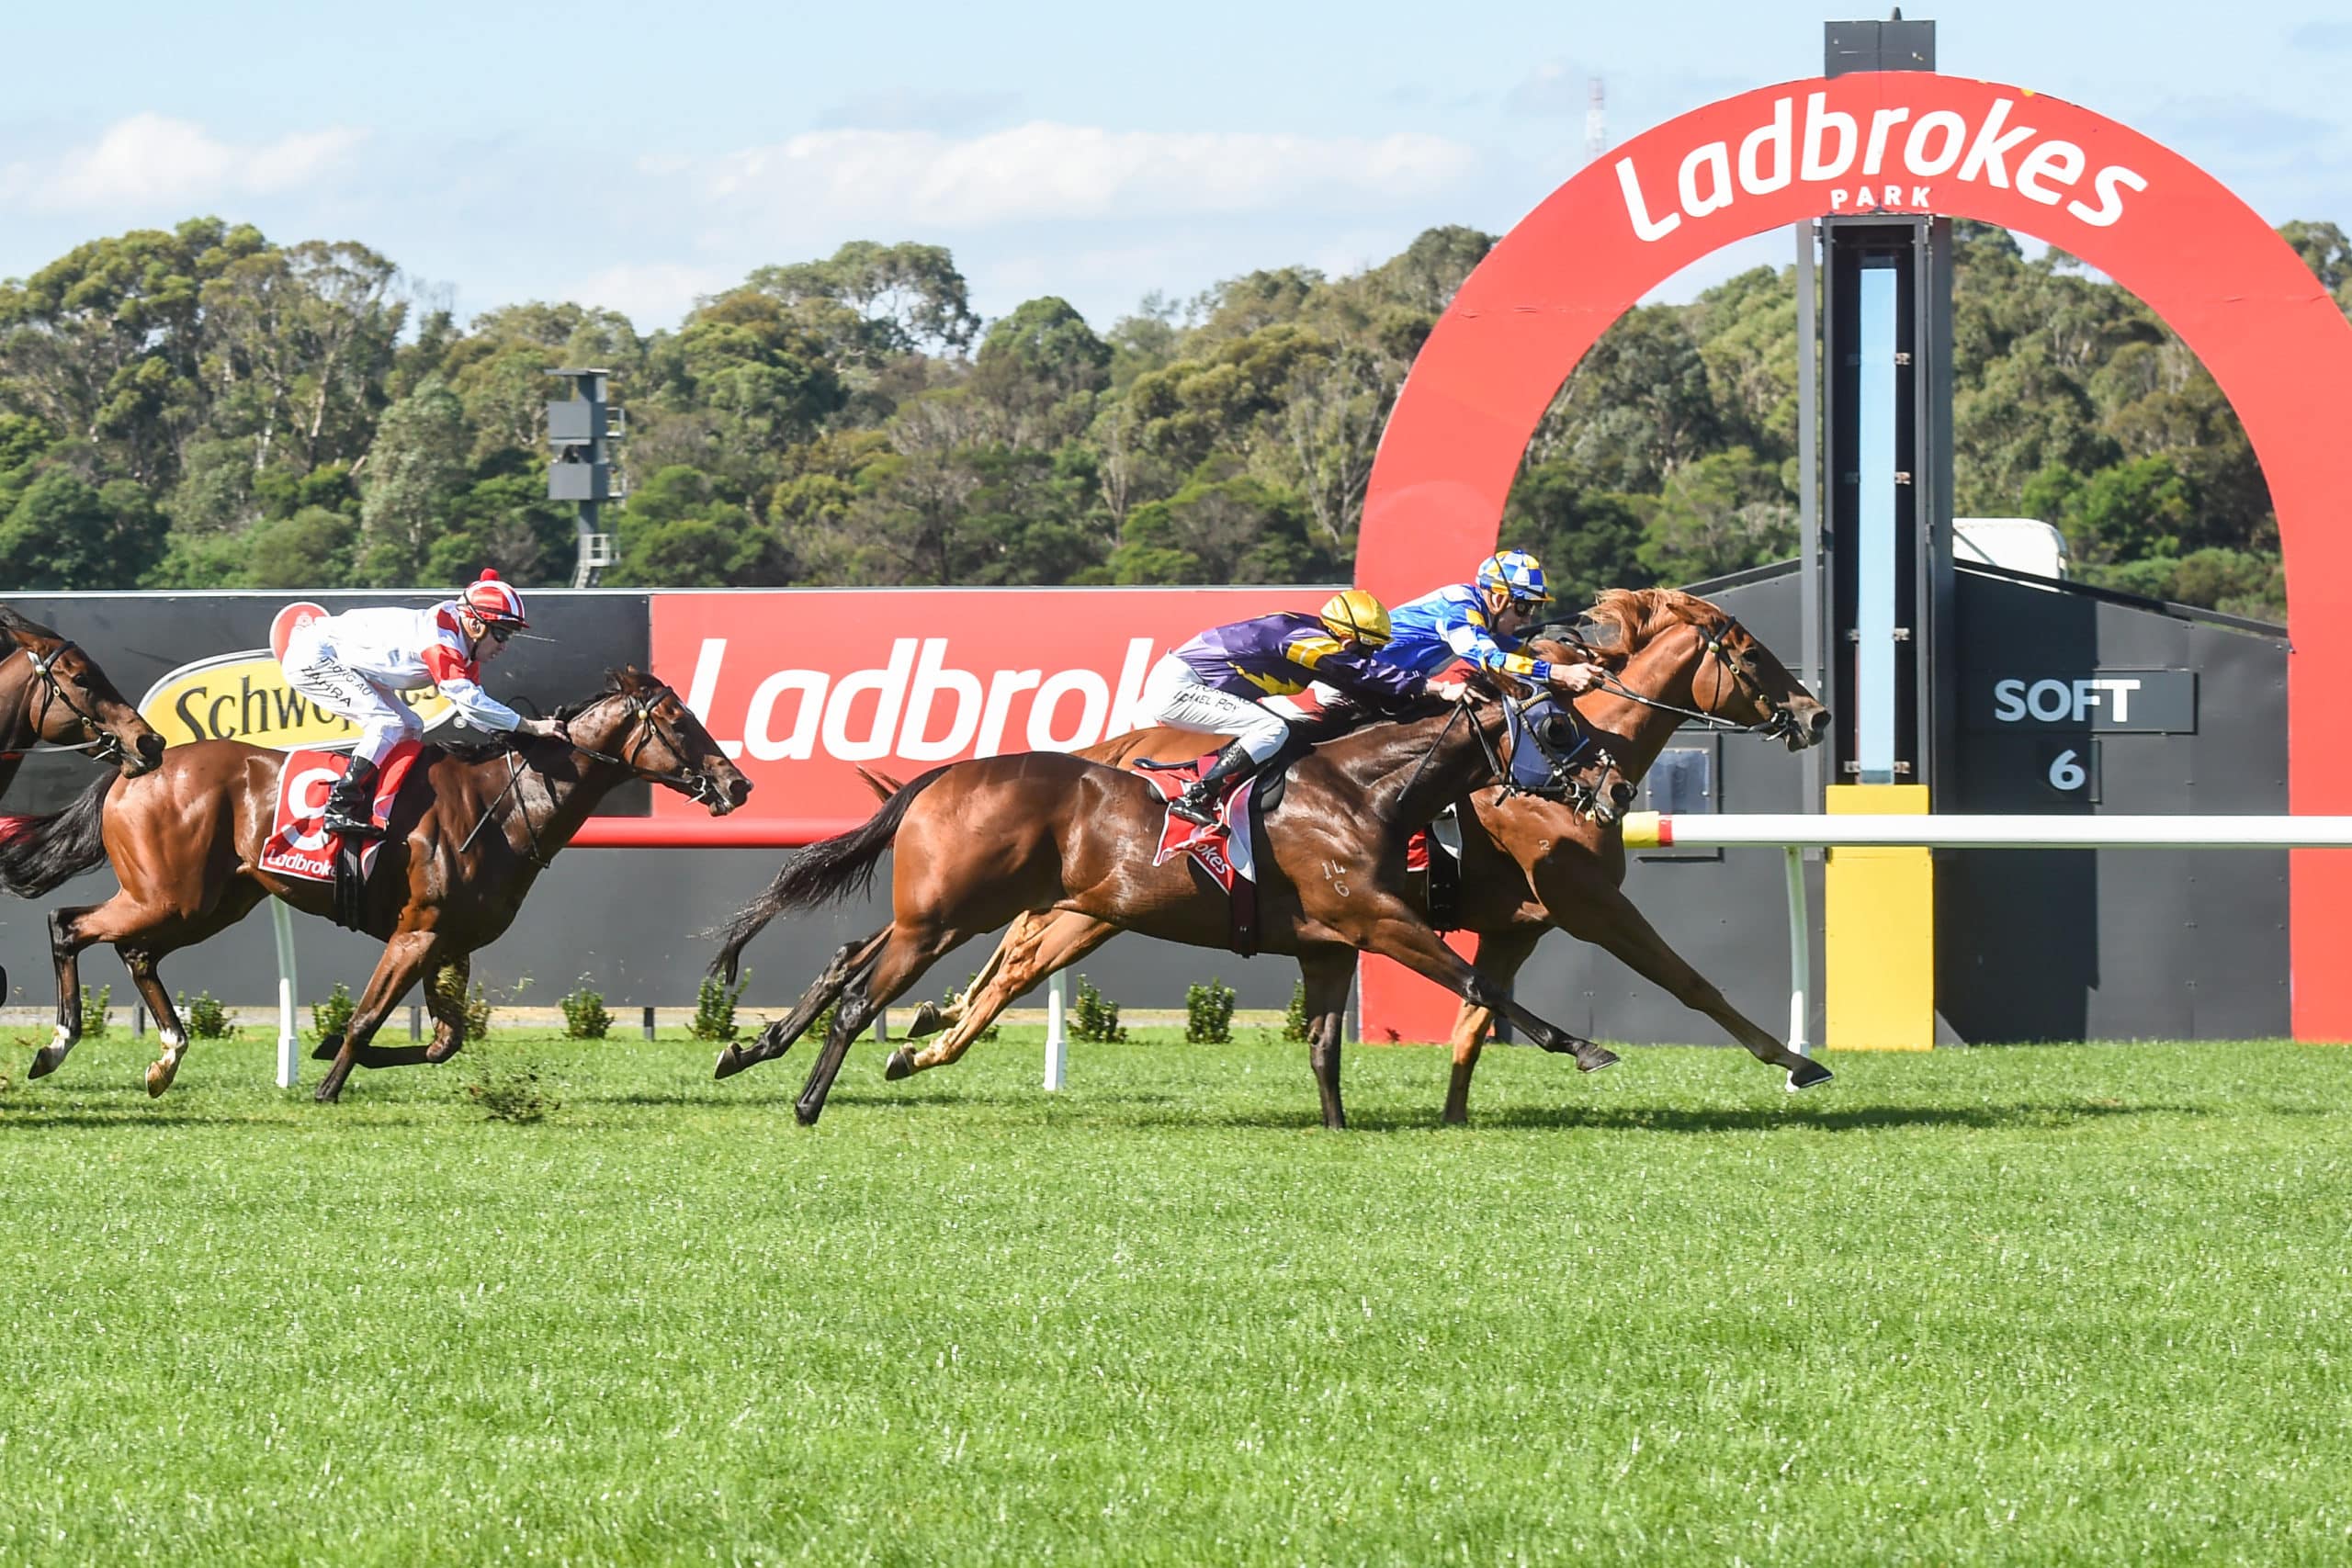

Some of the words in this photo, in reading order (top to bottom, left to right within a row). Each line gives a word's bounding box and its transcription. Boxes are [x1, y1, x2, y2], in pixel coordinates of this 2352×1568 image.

[1615, 92, 2148, 242] Ladbrokes
[1830, 186, 1931, 210] PARK
[686, 637, 1159, 761] Ladbrok
[1994, 679, 2142, 723] SOFT
[2049, 749, 2086, 791] 6
[280, 767, 342, 852] 9
[1334, 880, 1350, 897] 6
